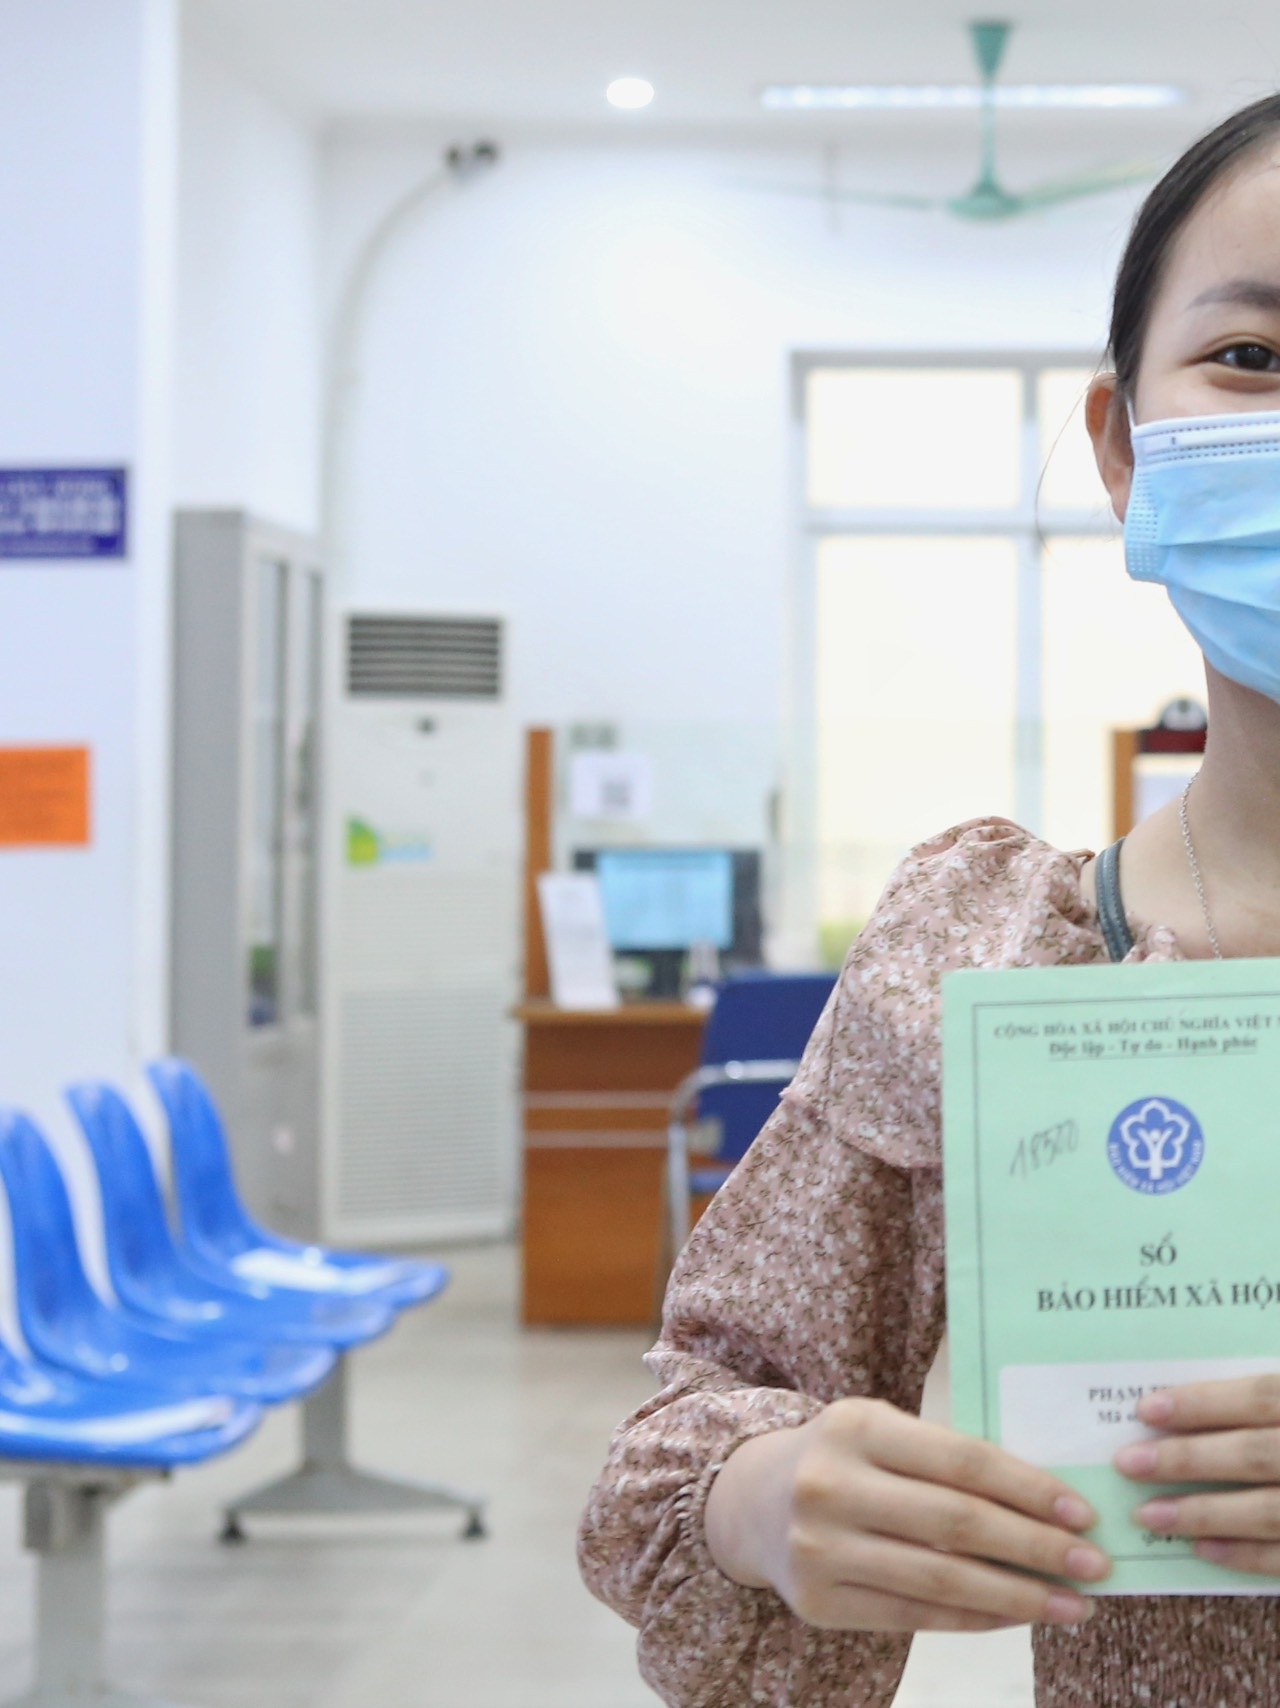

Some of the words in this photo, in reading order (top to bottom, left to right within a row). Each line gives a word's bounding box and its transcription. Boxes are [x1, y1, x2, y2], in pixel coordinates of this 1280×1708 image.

[993, 1021, 1039, 1039] CỘNG
[1081, 1018, 1102, 1034] XÃ
[1108, 1017, 1137, 1034] HỘI
[1235, 1013, 1273, 1030] VIỆT
[1144, 1038, 1163, 1051] do
[1037, 1281, 1096, 1312] BẢO
[1185, 1278, 1224, 1307] XÃ
